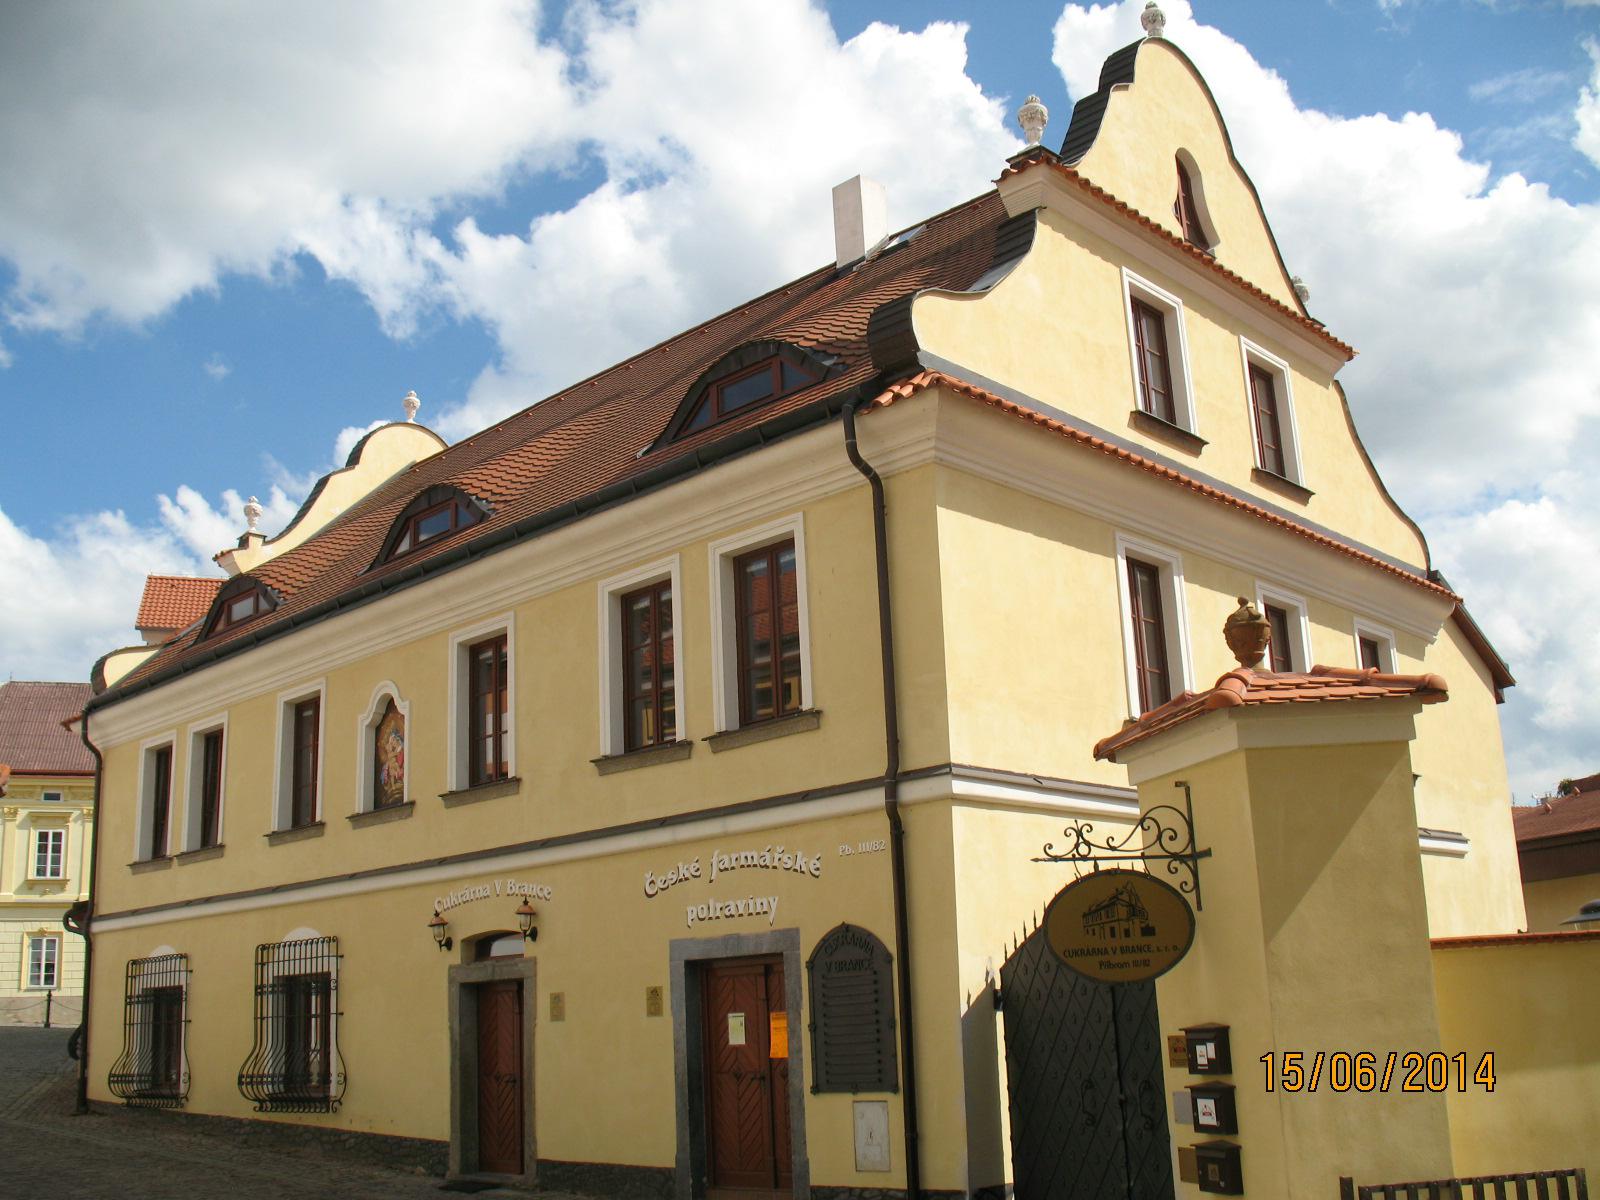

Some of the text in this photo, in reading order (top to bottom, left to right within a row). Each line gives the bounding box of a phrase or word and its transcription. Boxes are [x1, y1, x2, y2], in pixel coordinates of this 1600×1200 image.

[643, 845, 822, 898] České farmářské
[434, 879, 552, 914] Cukrárna V Brance
